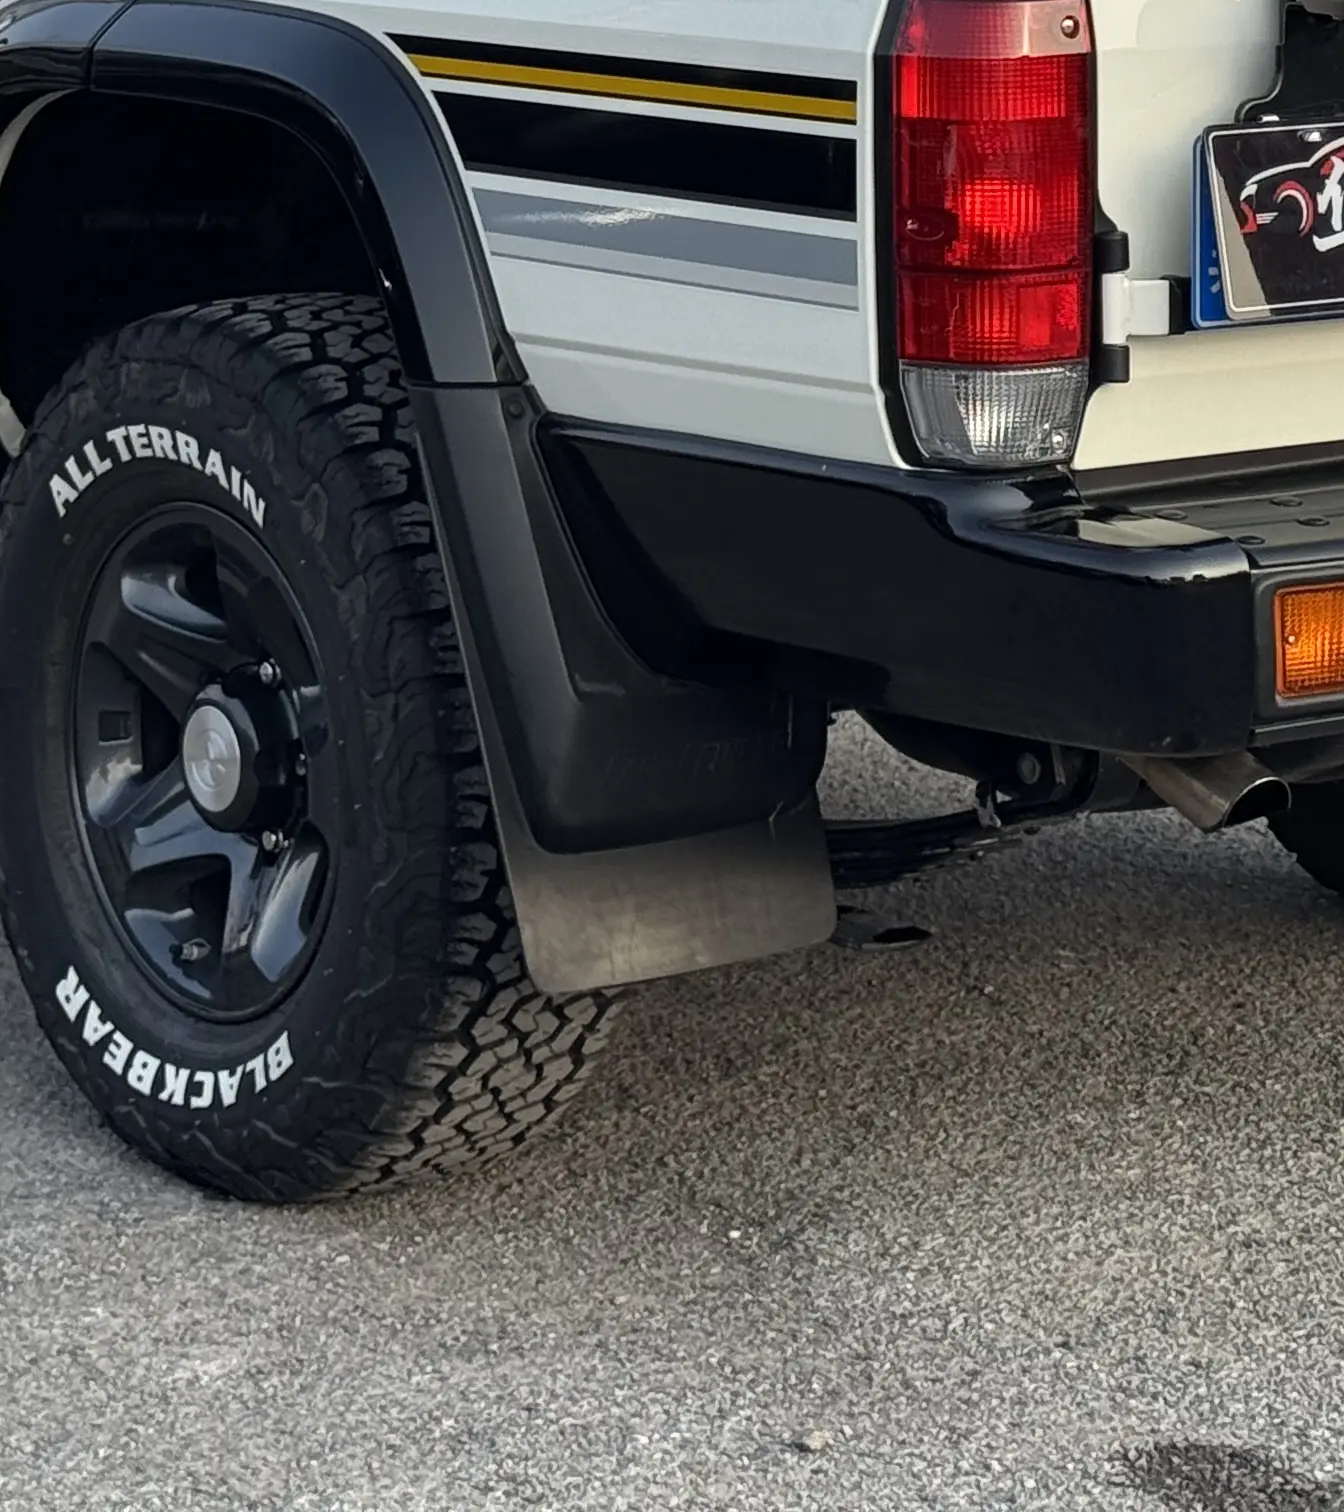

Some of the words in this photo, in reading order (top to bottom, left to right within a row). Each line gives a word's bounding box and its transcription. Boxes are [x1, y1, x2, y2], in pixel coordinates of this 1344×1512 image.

[48, 439, 114, 519] ALL
[106, 423, 267, 529] TERRAIN
[55, 964, 295, 1111] BLACKBEAR
